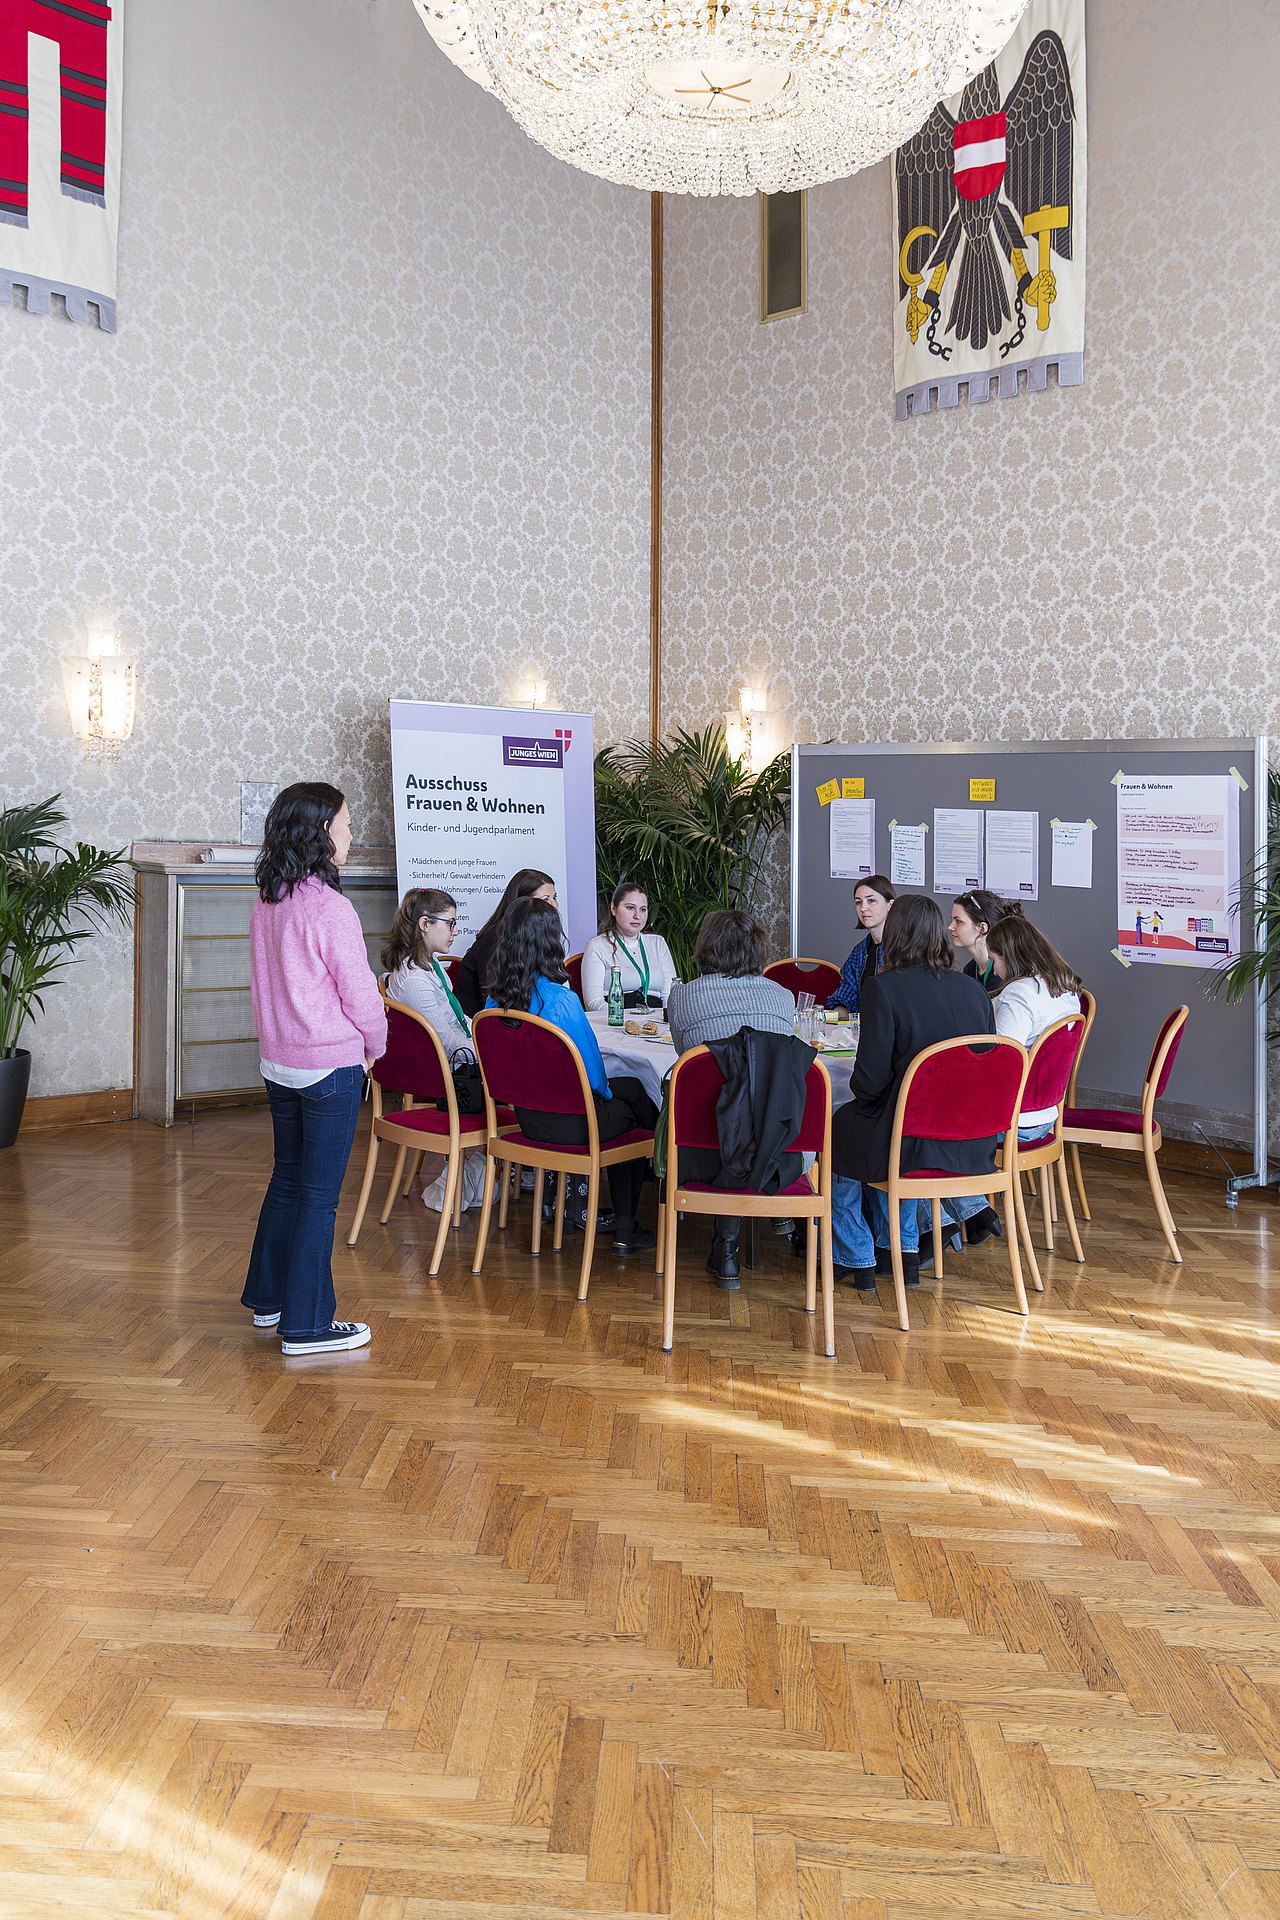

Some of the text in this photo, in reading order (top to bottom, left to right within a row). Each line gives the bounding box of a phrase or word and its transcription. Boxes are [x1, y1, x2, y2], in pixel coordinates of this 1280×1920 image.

[511, 750, 556, 759] JUNGES WIEN
[405, 774, 488, 792] Ausschuss
[406, 795, 545, 814] Frauen & Wohnen
[407, 823, 535, 836] Kinder- und Jugendparlament
[411, 858, 443, 866] Mädchen
[444, 858, 457, 866] und
[457, 859, 476, 867] junge
[412, 871, 449, 880] Sicherheit/
[472, 872, 506, 880] verhindern
